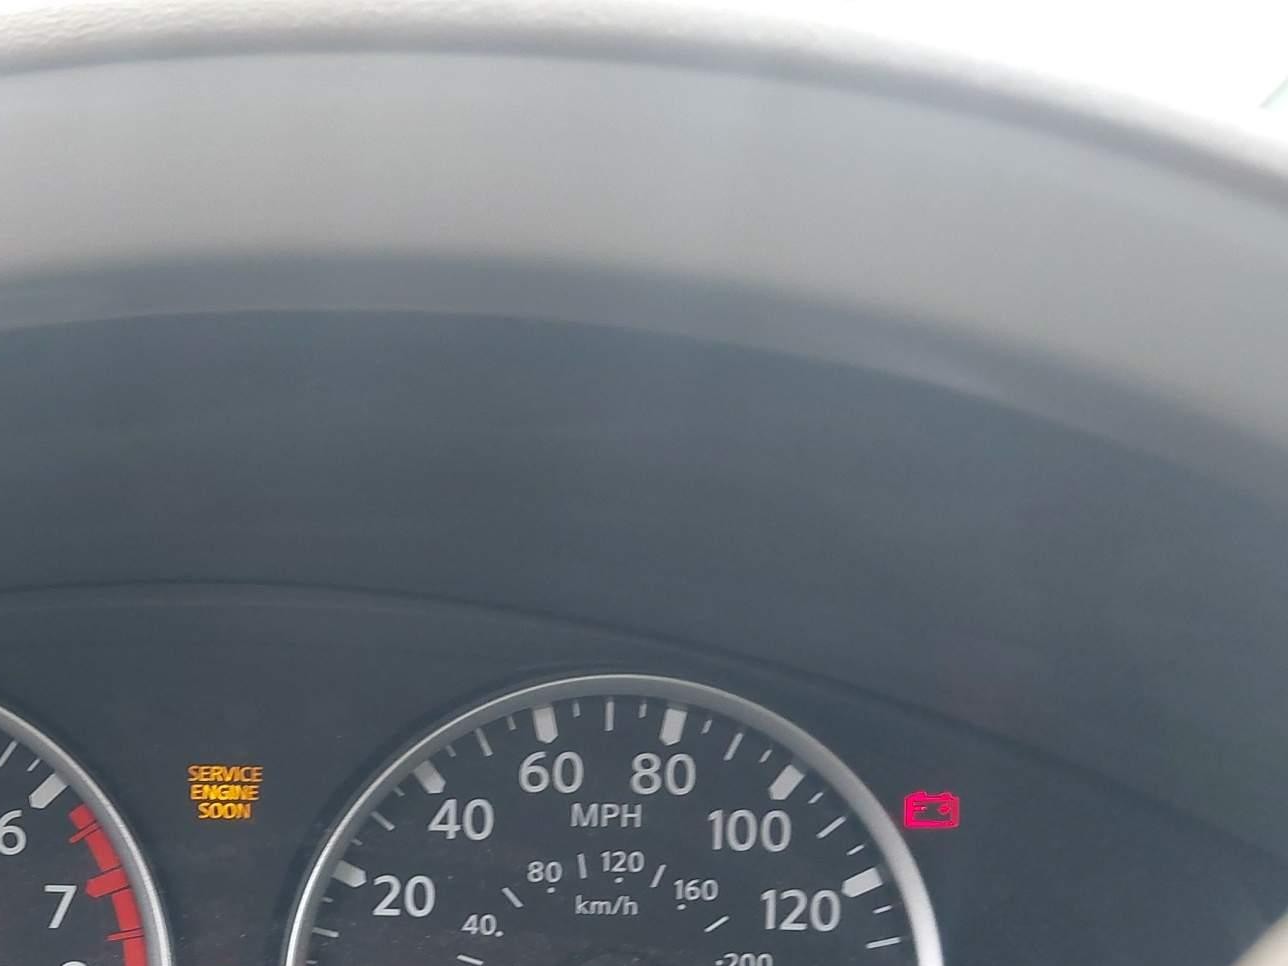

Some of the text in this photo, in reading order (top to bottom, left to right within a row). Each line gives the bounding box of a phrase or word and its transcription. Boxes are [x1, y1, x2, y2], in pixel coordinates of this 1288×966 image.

[188, 765, 263, 783] SERVICE
[519, 752, 583, 793] 60
[631, 754, 695, 795] 80
[190, 784, 258, 801] ENGINE
[198, 802, 251, 820] SOON
[430, 799, 494, 841] 40
[571, 805, 642, 828] MPH
[710, 809, 791, 851] 100
[528, 861, 563, 884] 80
[601, 851, 644, 873] 120
[373, 876, 434, 917] 20
[674, 879, 718, 902] 160
[45, 886, 76, 928] 7
[575, 894, 639, 918] km/h
[762, 891, 840, 931] 120
[463, 914, 496, 936] 40
